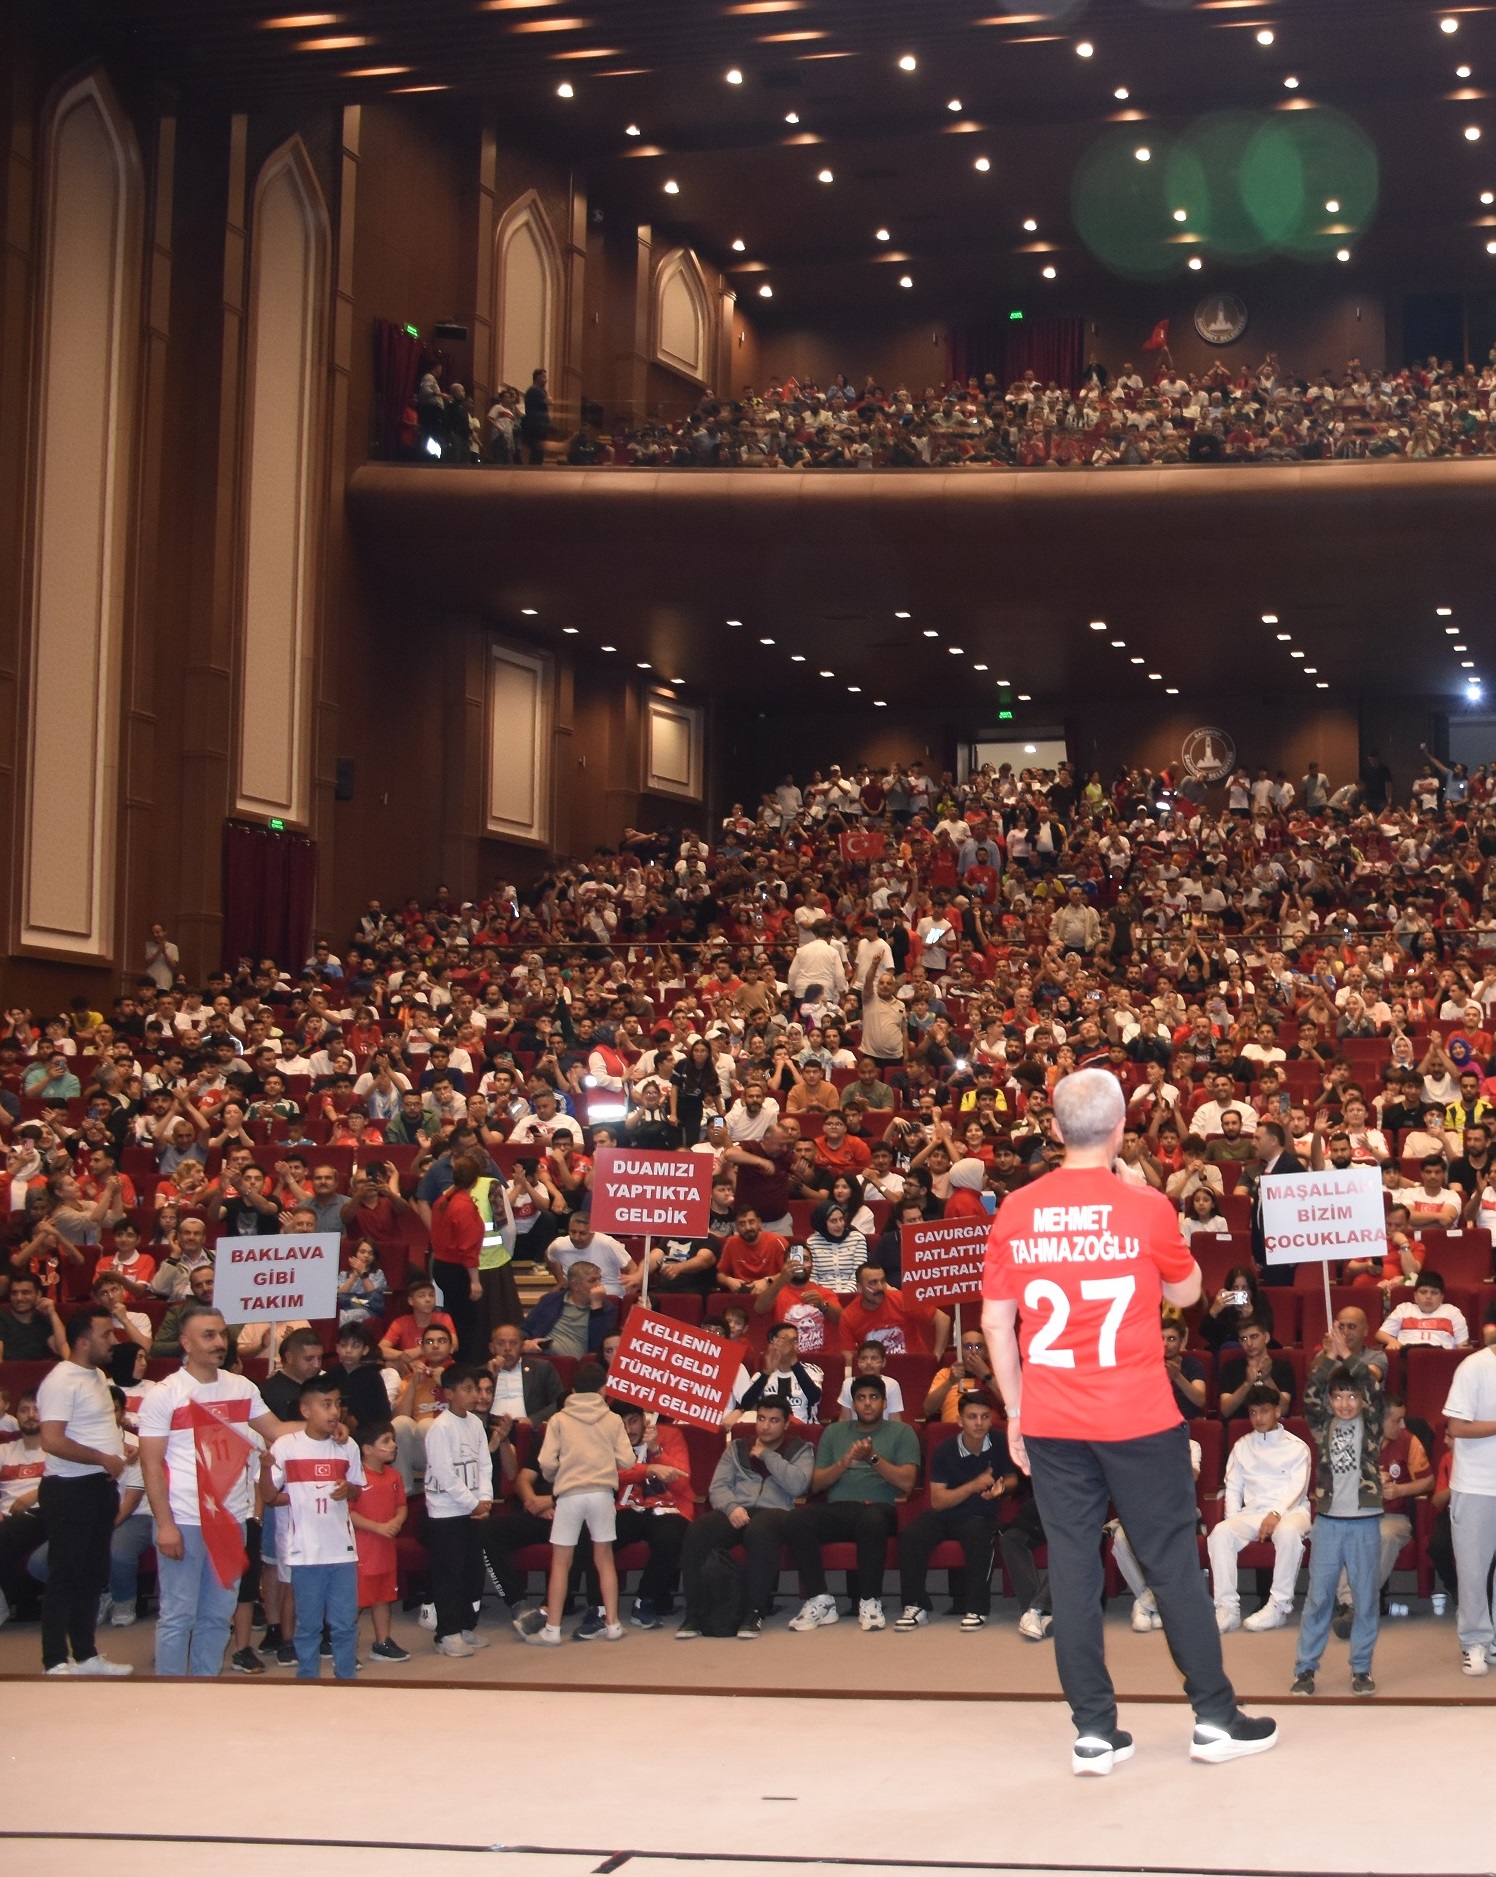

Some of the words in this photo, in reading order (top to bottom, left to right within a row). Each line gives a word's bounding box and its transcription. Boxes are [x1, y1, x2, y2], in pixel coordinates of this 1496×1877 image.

[613, 1160, 695, 1177] DUAMIZI
[605, 1183, 701, 1201] YAPTIKTA
[615, 1206, 688, 1224] GELDİK
[1033, 1205, 1113, 1233] MEHMET
[1297, 1204, 1352, 1223] BİZİM
[914, 1224, 994, 1244] GAVURGAY
[1264, 1228, 1387, 1253] ÇOCUKLARA
[231, 1245, 325, 1263] BAKLAVA
[1010, 1230, 1140, 1264] TAHMAZOĞLU
[253, 1267, 296, 1286] GİBİ
[902, 1261, 985, 1283] AVUSTRALY
[915, 1280, 983, 1302] ÇATLATTI
[240, 1294, 304, 1311] TAKIM
[1024, 1274, 1136, 1369] 27
[641, 1319, 722, 1359] KELLENİN
[629, 1337, 669, 1362] KEFİ
[671, 1352, 721, 1380] GELDİ
[605, 1375, 657, 1402] KEYFİ
[619, 1355, 723, 1403] TÜRKİYE'NİN
[315, 1497, 328, 1515] 11
